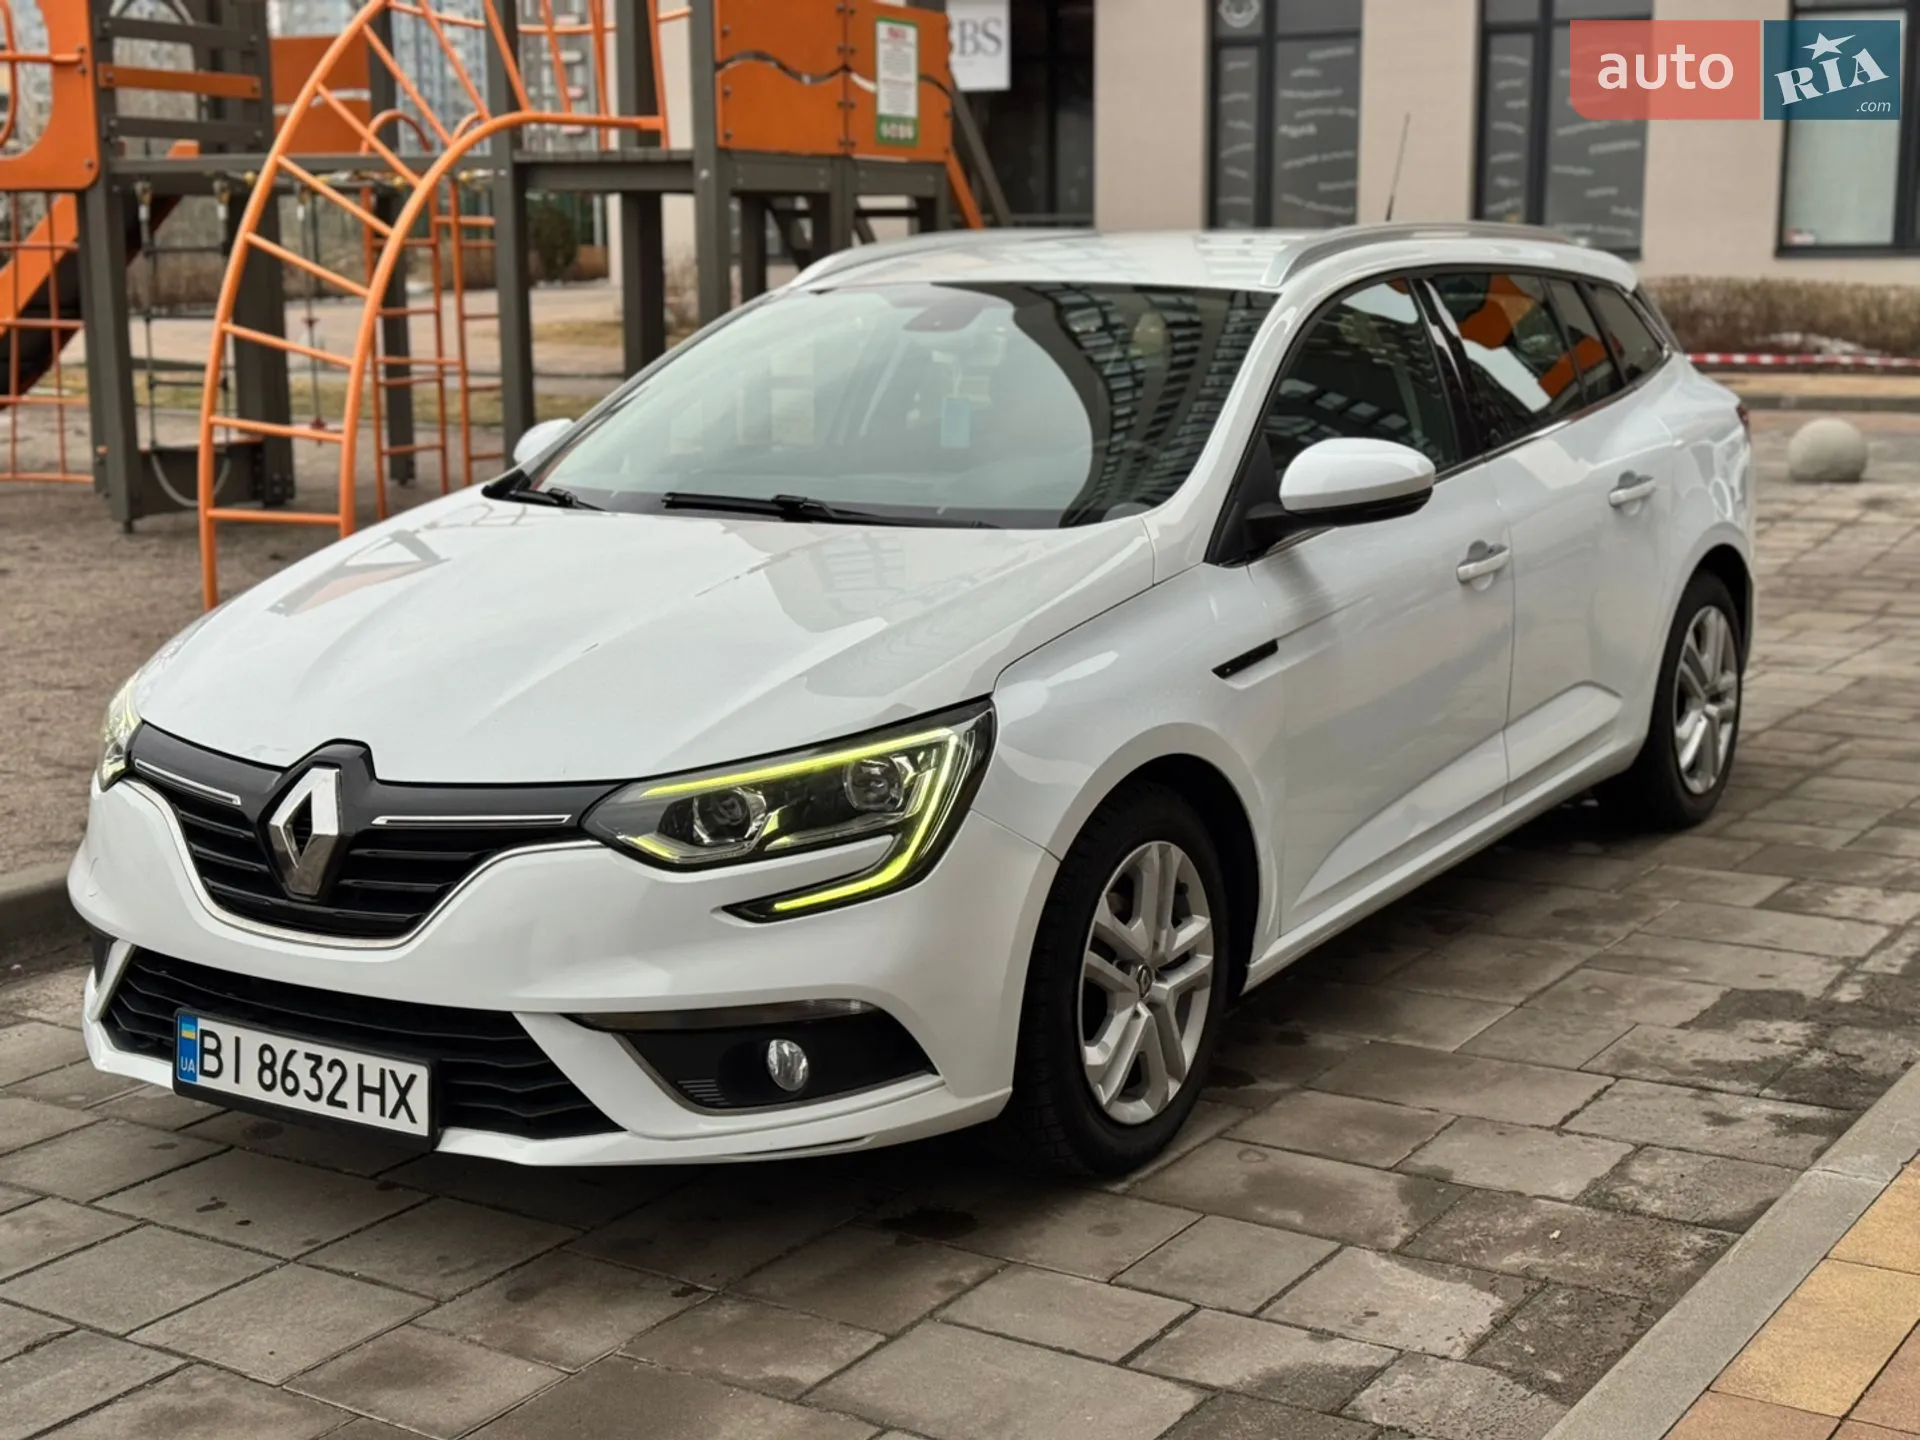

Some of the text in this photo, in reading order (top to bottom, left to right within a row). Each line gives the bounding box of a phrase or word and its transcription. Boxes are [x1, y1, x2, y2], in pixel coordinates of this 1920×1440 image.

[180, 1055, 196, 1074] UA
[199, 1028, 418, 1125] BI 8632 HX
